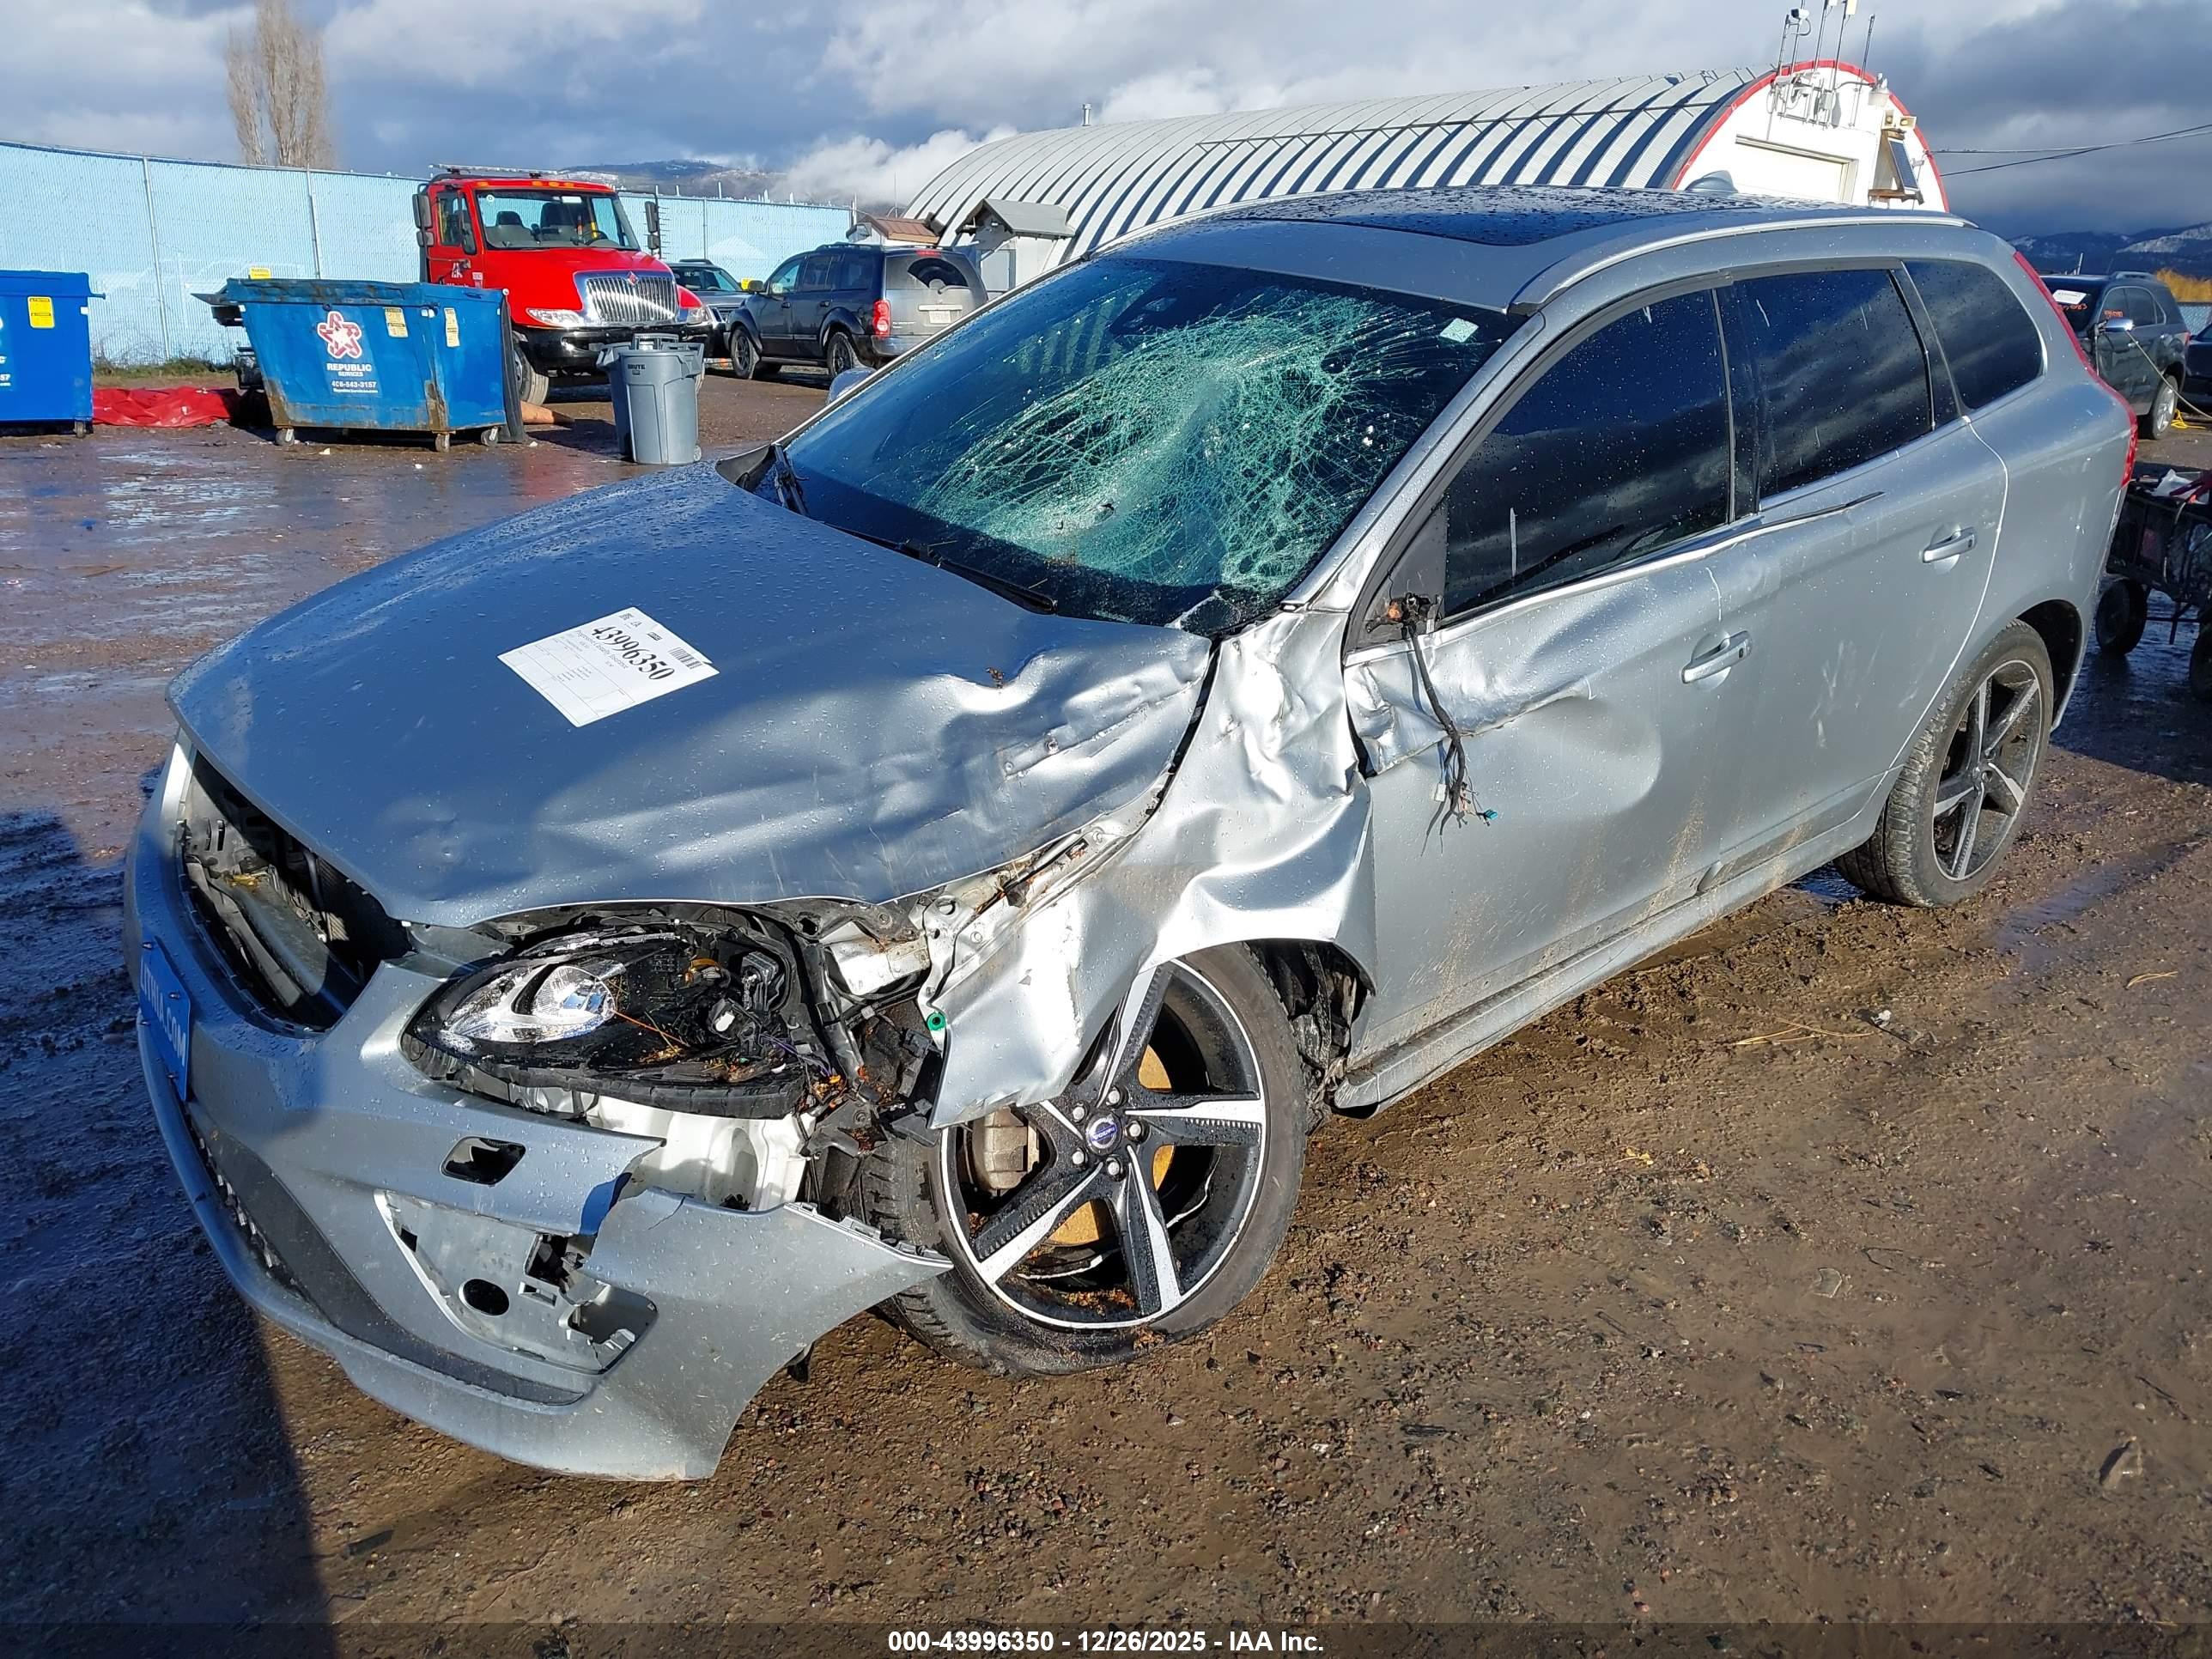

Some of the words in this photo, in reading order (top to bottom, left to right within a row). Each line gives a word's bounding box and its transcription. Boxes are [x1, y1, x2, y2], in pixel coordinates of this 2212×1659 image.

[326, 362, 373, 372] REPUBLIC
[591, 626, 676, 680] 43996350
[140, 956, 186, 1067] LITHIA.COM
[1091, 1125, 1116, 1140] VOLVO
